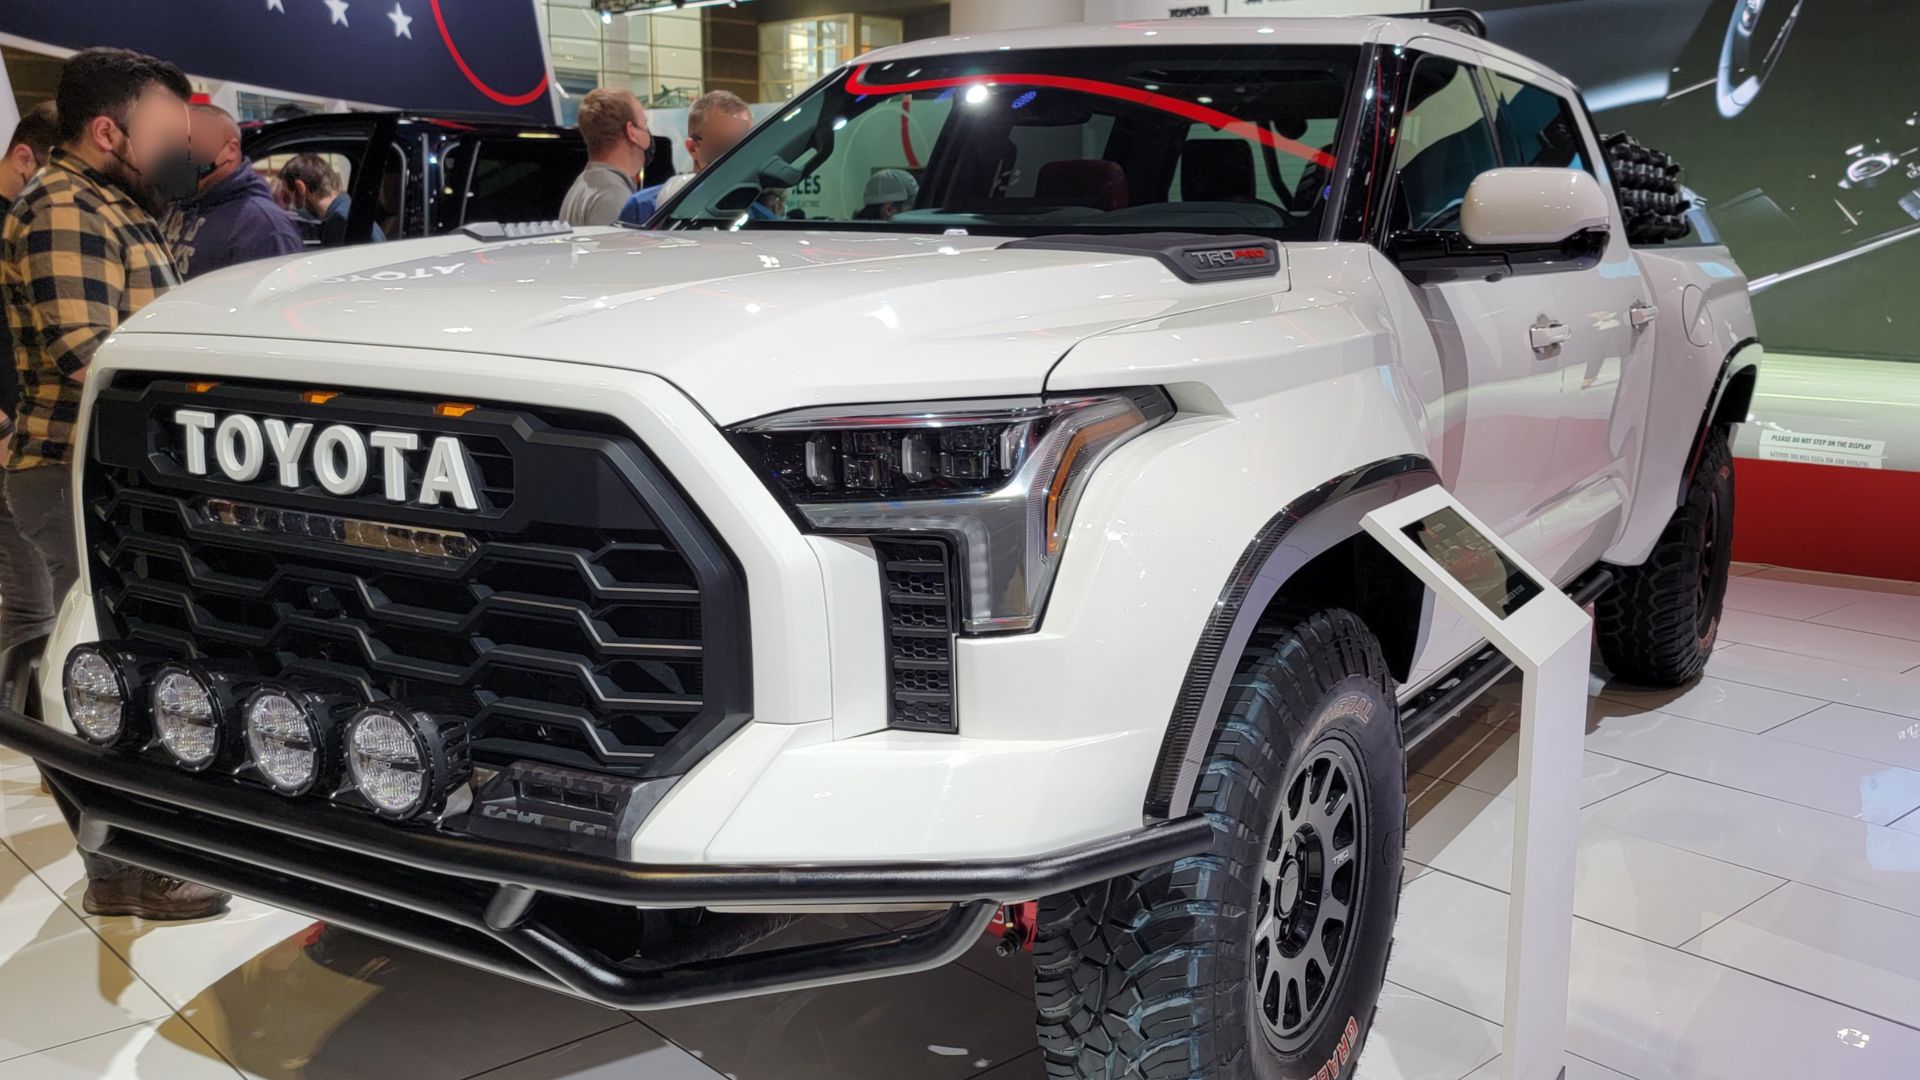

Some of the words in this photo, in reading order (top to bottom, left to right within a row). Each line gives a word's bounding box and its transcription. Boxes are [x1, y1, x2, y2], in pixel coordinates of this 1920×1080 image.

[792, 175, 822, 195] LES
[320, 263, 466, 284] TOYOTA
[1848, 442, 1872, 450] DISPLAY
[1308, 1016, 1359, 1080] GRAB
